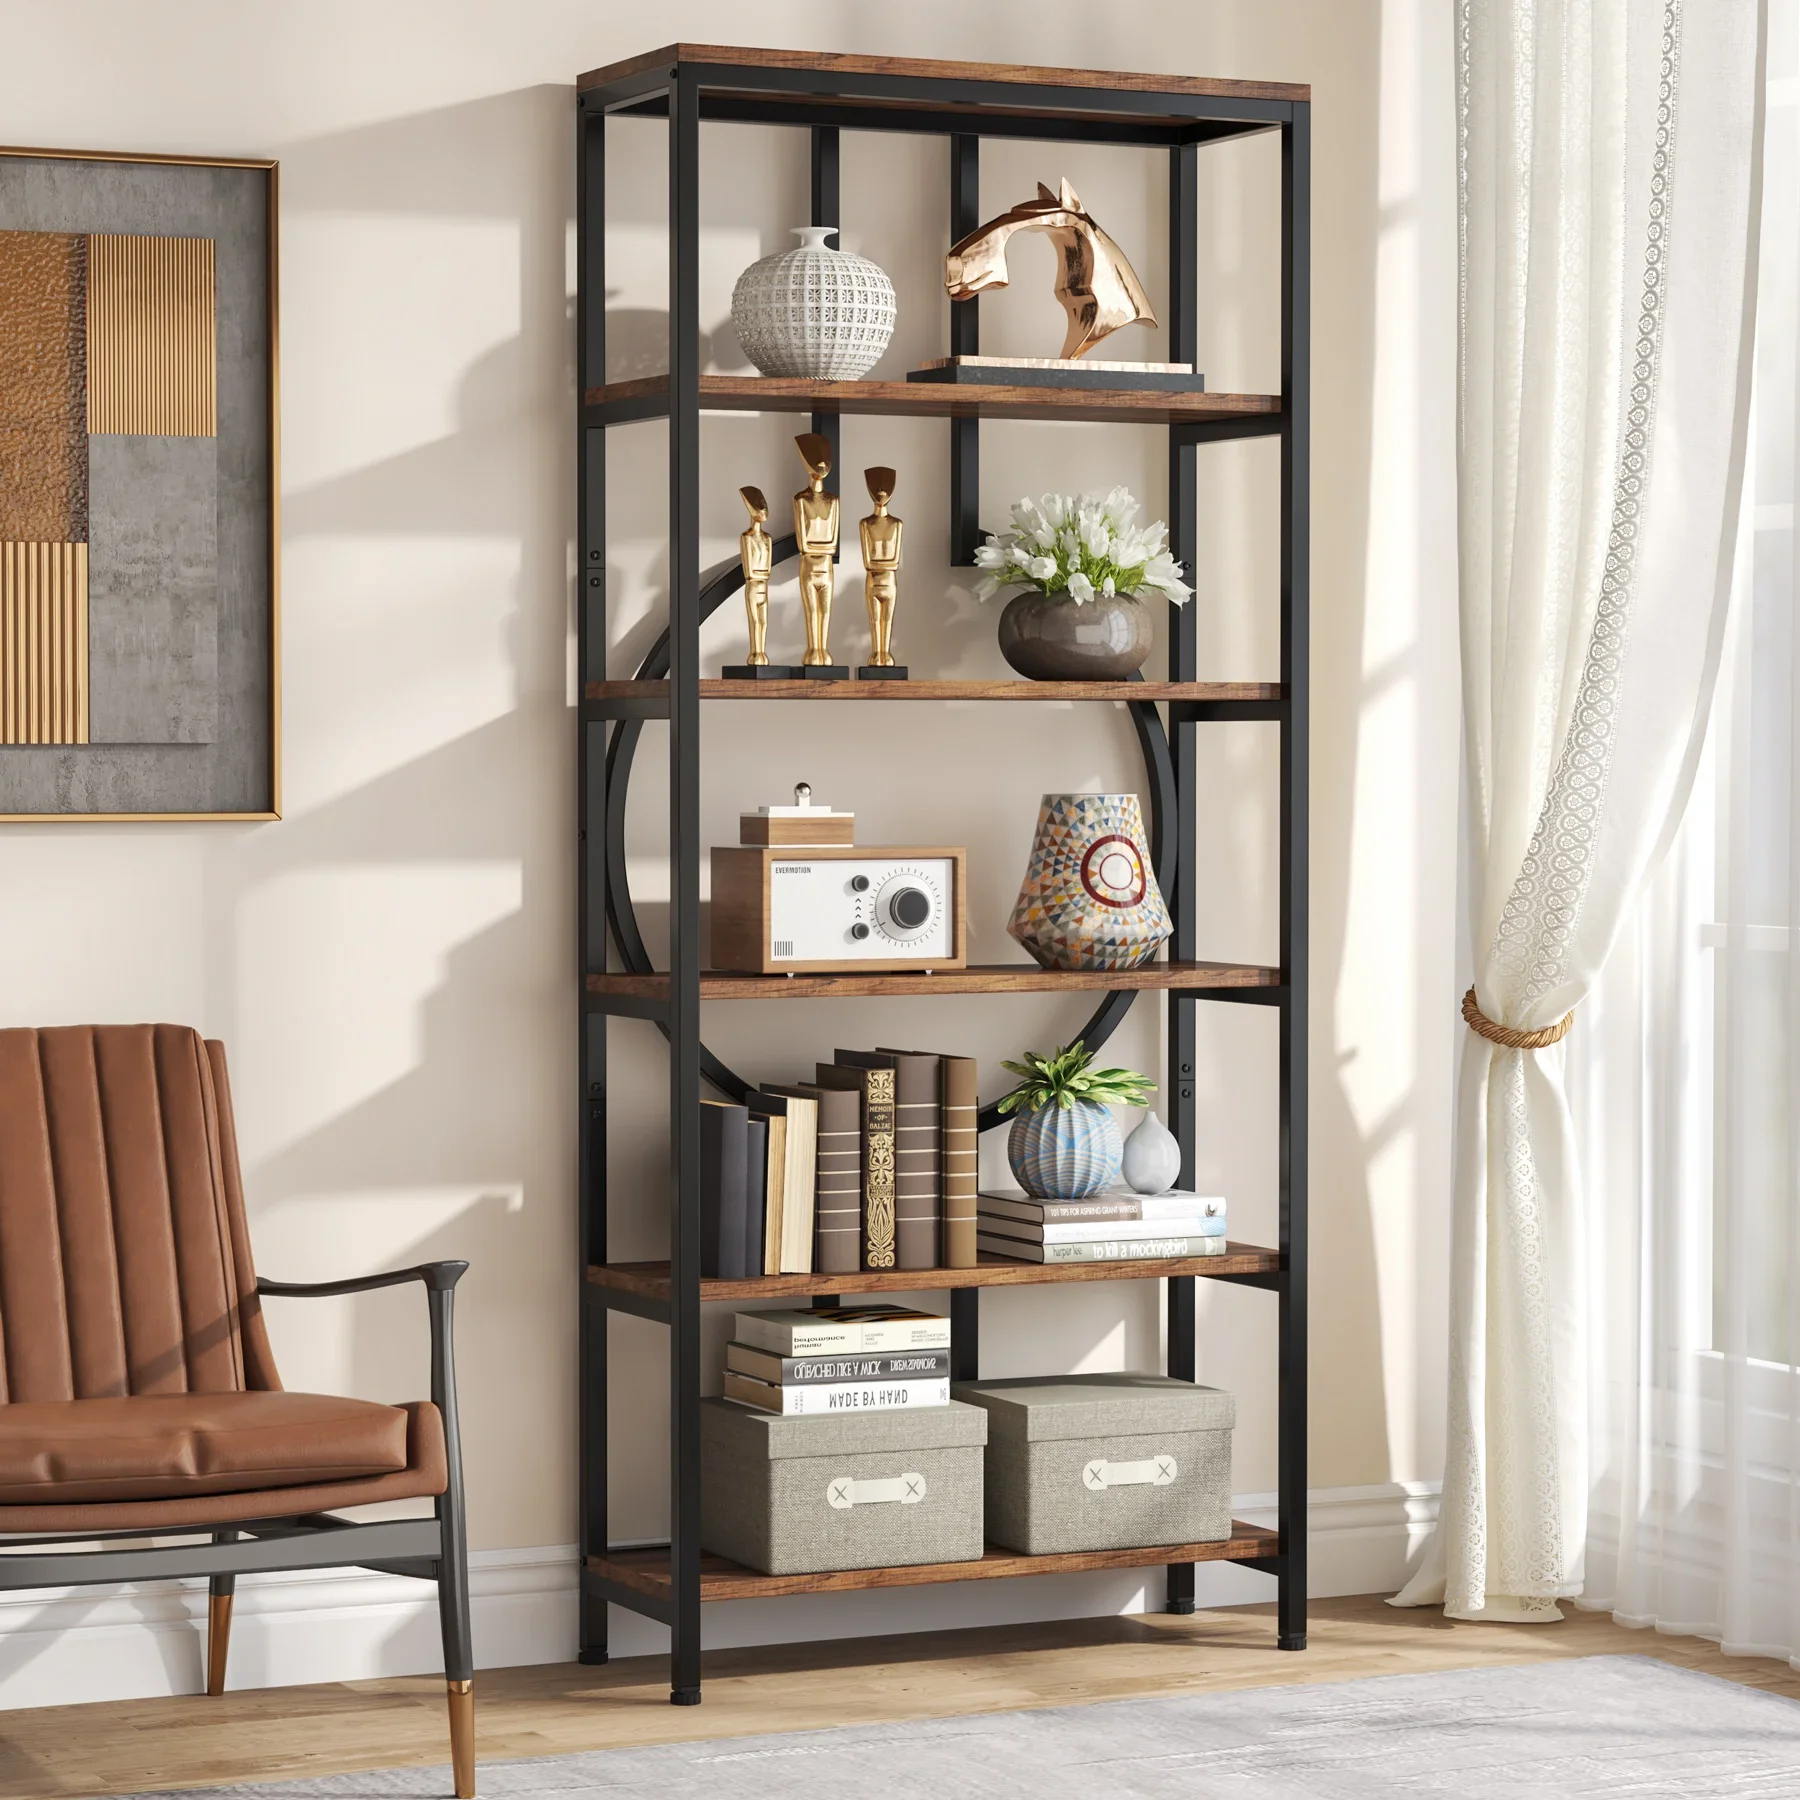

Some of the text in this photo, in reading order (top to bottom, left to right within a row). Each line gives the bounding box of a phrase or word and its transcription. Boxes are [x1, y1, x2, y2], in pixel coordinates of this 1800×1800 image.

[1060, 1208, 1069, 1216] TIPS
[1070, 1207, 1080, 1216] FOR
[1080, 1206, 1101, 1215] ASPIRING
[1102, 1205, 1118, 1214] GRANT
[1118, 1205, 1138, 1213] WRITERS
[1053, 1245, 1082, 1258] harper lee
[1093, 1238, 1187, 1258] to kill a mockingbird
